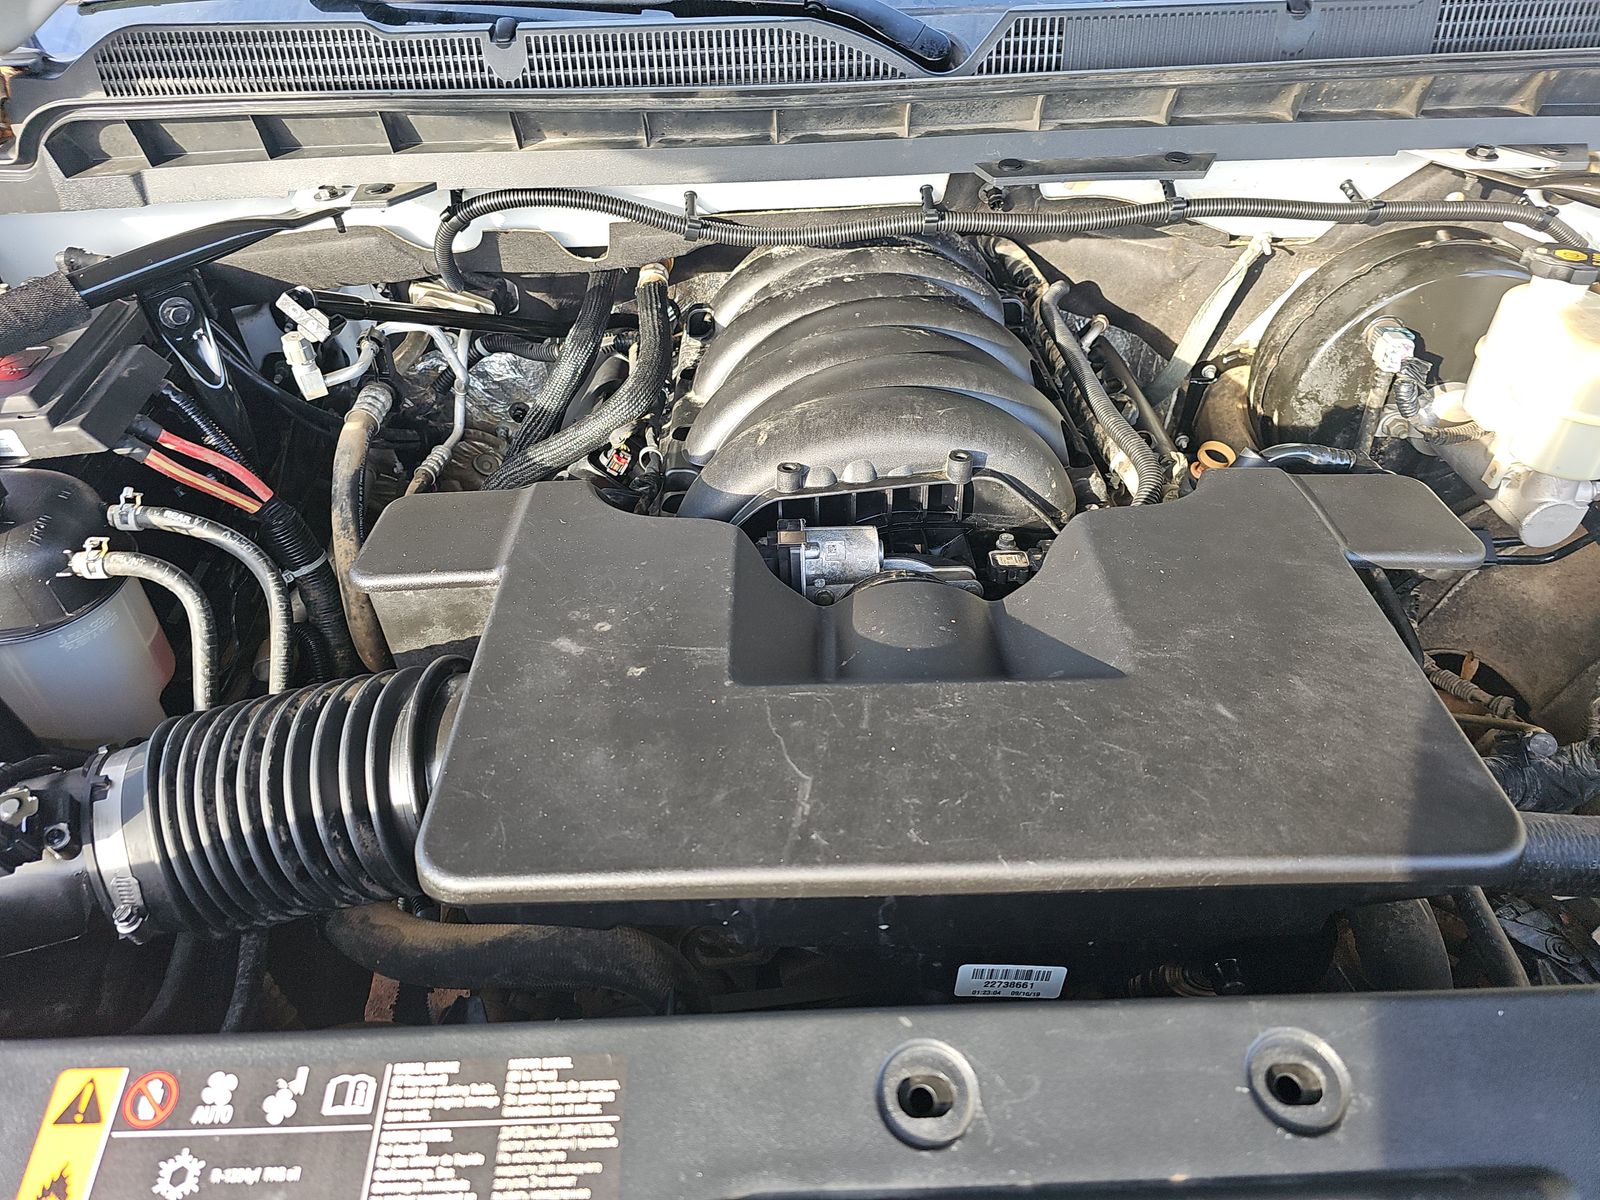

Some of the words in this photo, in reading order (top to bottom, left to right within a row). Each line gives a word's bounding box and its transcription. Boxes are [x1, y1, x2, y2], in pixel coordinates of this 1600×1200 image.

[163, 509, 192, 525] REAR
[983, 981, 1034, 989] 22738661
[190, 1104, 234, 1125] AUTO
